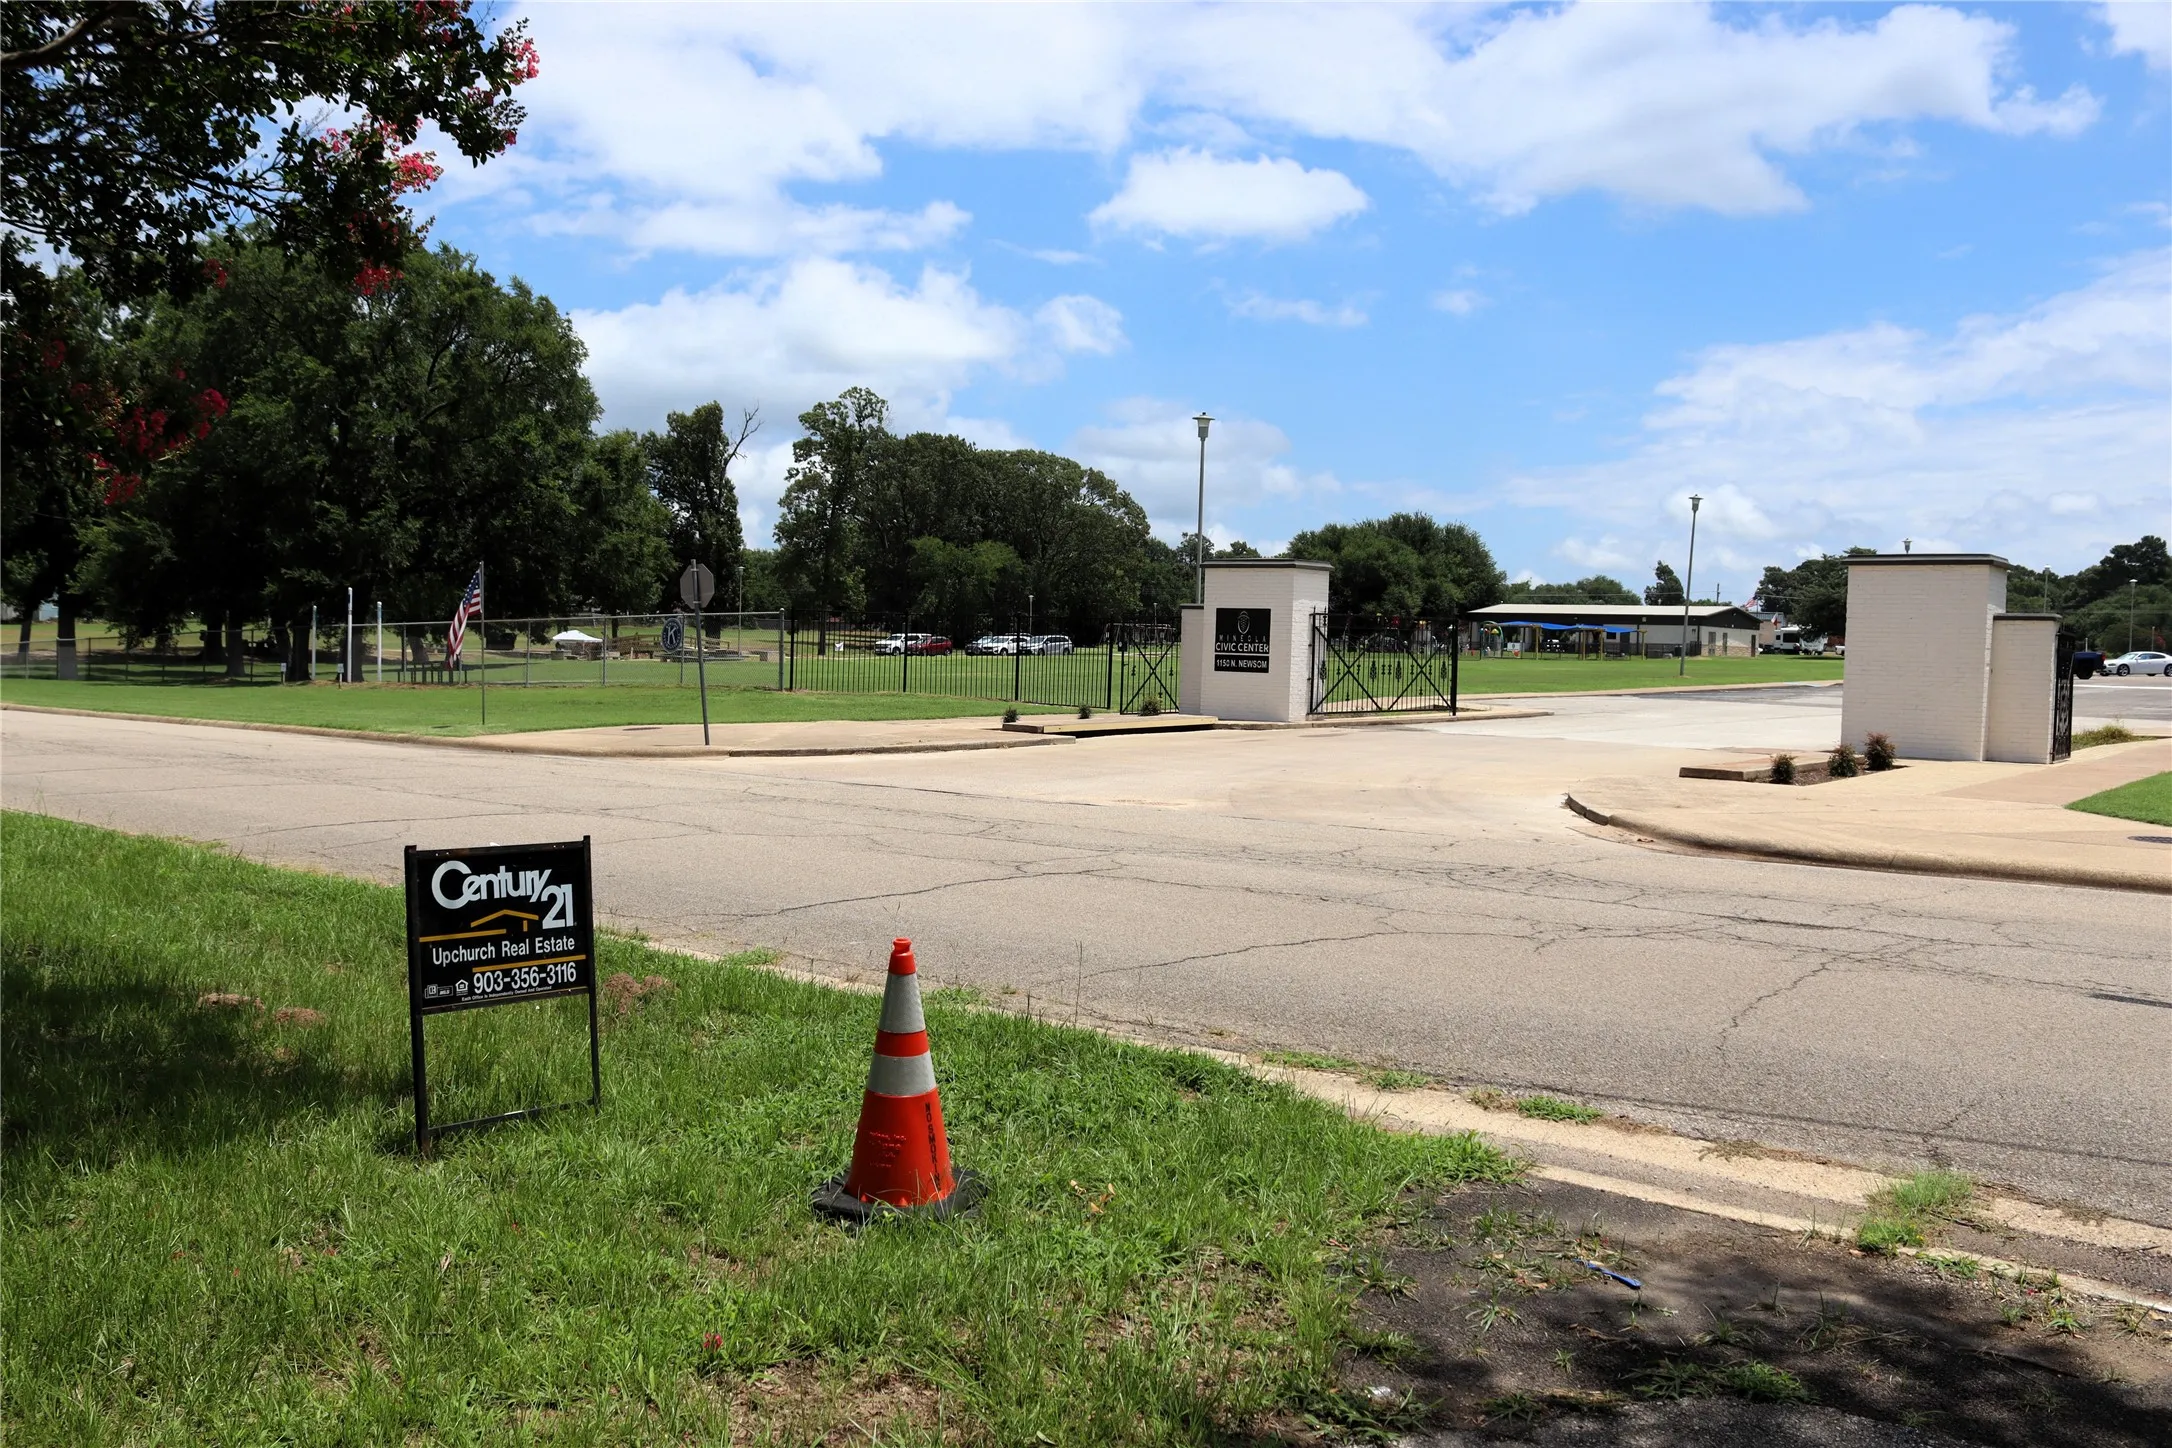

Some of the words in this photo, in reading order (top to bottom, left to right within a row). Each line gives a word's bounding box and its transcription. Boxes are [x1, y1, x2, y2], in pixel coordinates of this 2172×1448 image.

[667, 626, 677, 645] K
[1215, 642, 1236, 652] CIVIC
[1237, 643, 1269, 653] CENTER
[1219, 634, 1266, 642] MINEOLA
[1216, 659, 1230, 667] 1150
[1230, 660, 1237, 668] N.
[1238, 660, 1267, 669] NEWSOM
[431, 860, 552, 910] Century
[540, 883, 574, 930] 21
[432, 942, 496, 968] Upchurch
[501, 938, 529, 957] Real
[535, 935, 575, 954] Estate
[473, 962, 577, 994] 903-356-3116
